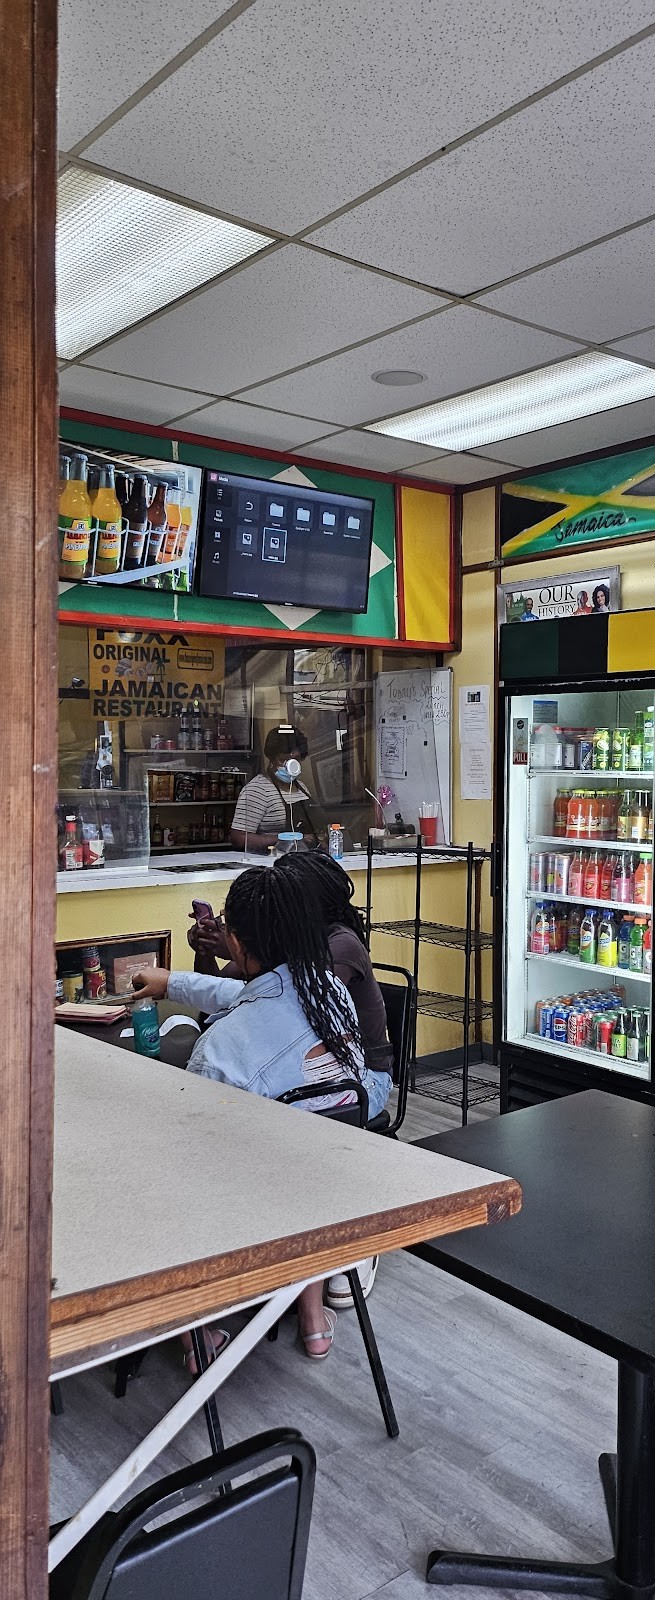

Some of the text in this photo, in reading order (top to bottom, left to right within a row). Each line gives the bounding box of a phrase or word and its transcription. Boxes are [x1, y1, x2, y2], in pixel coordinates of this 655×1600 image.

[550, 512, 627, 542] Jamaica
[538, 584, 575, 604] OUR
[538, 603, 576, 617] HISTORY
[93, 644, 171, 663] ORIGINAL
[94, 679, 222, 700] JAMAICAN
[93, 699, 222, 719] RESTAURANT
[514, 752, 528, 763] PULL
